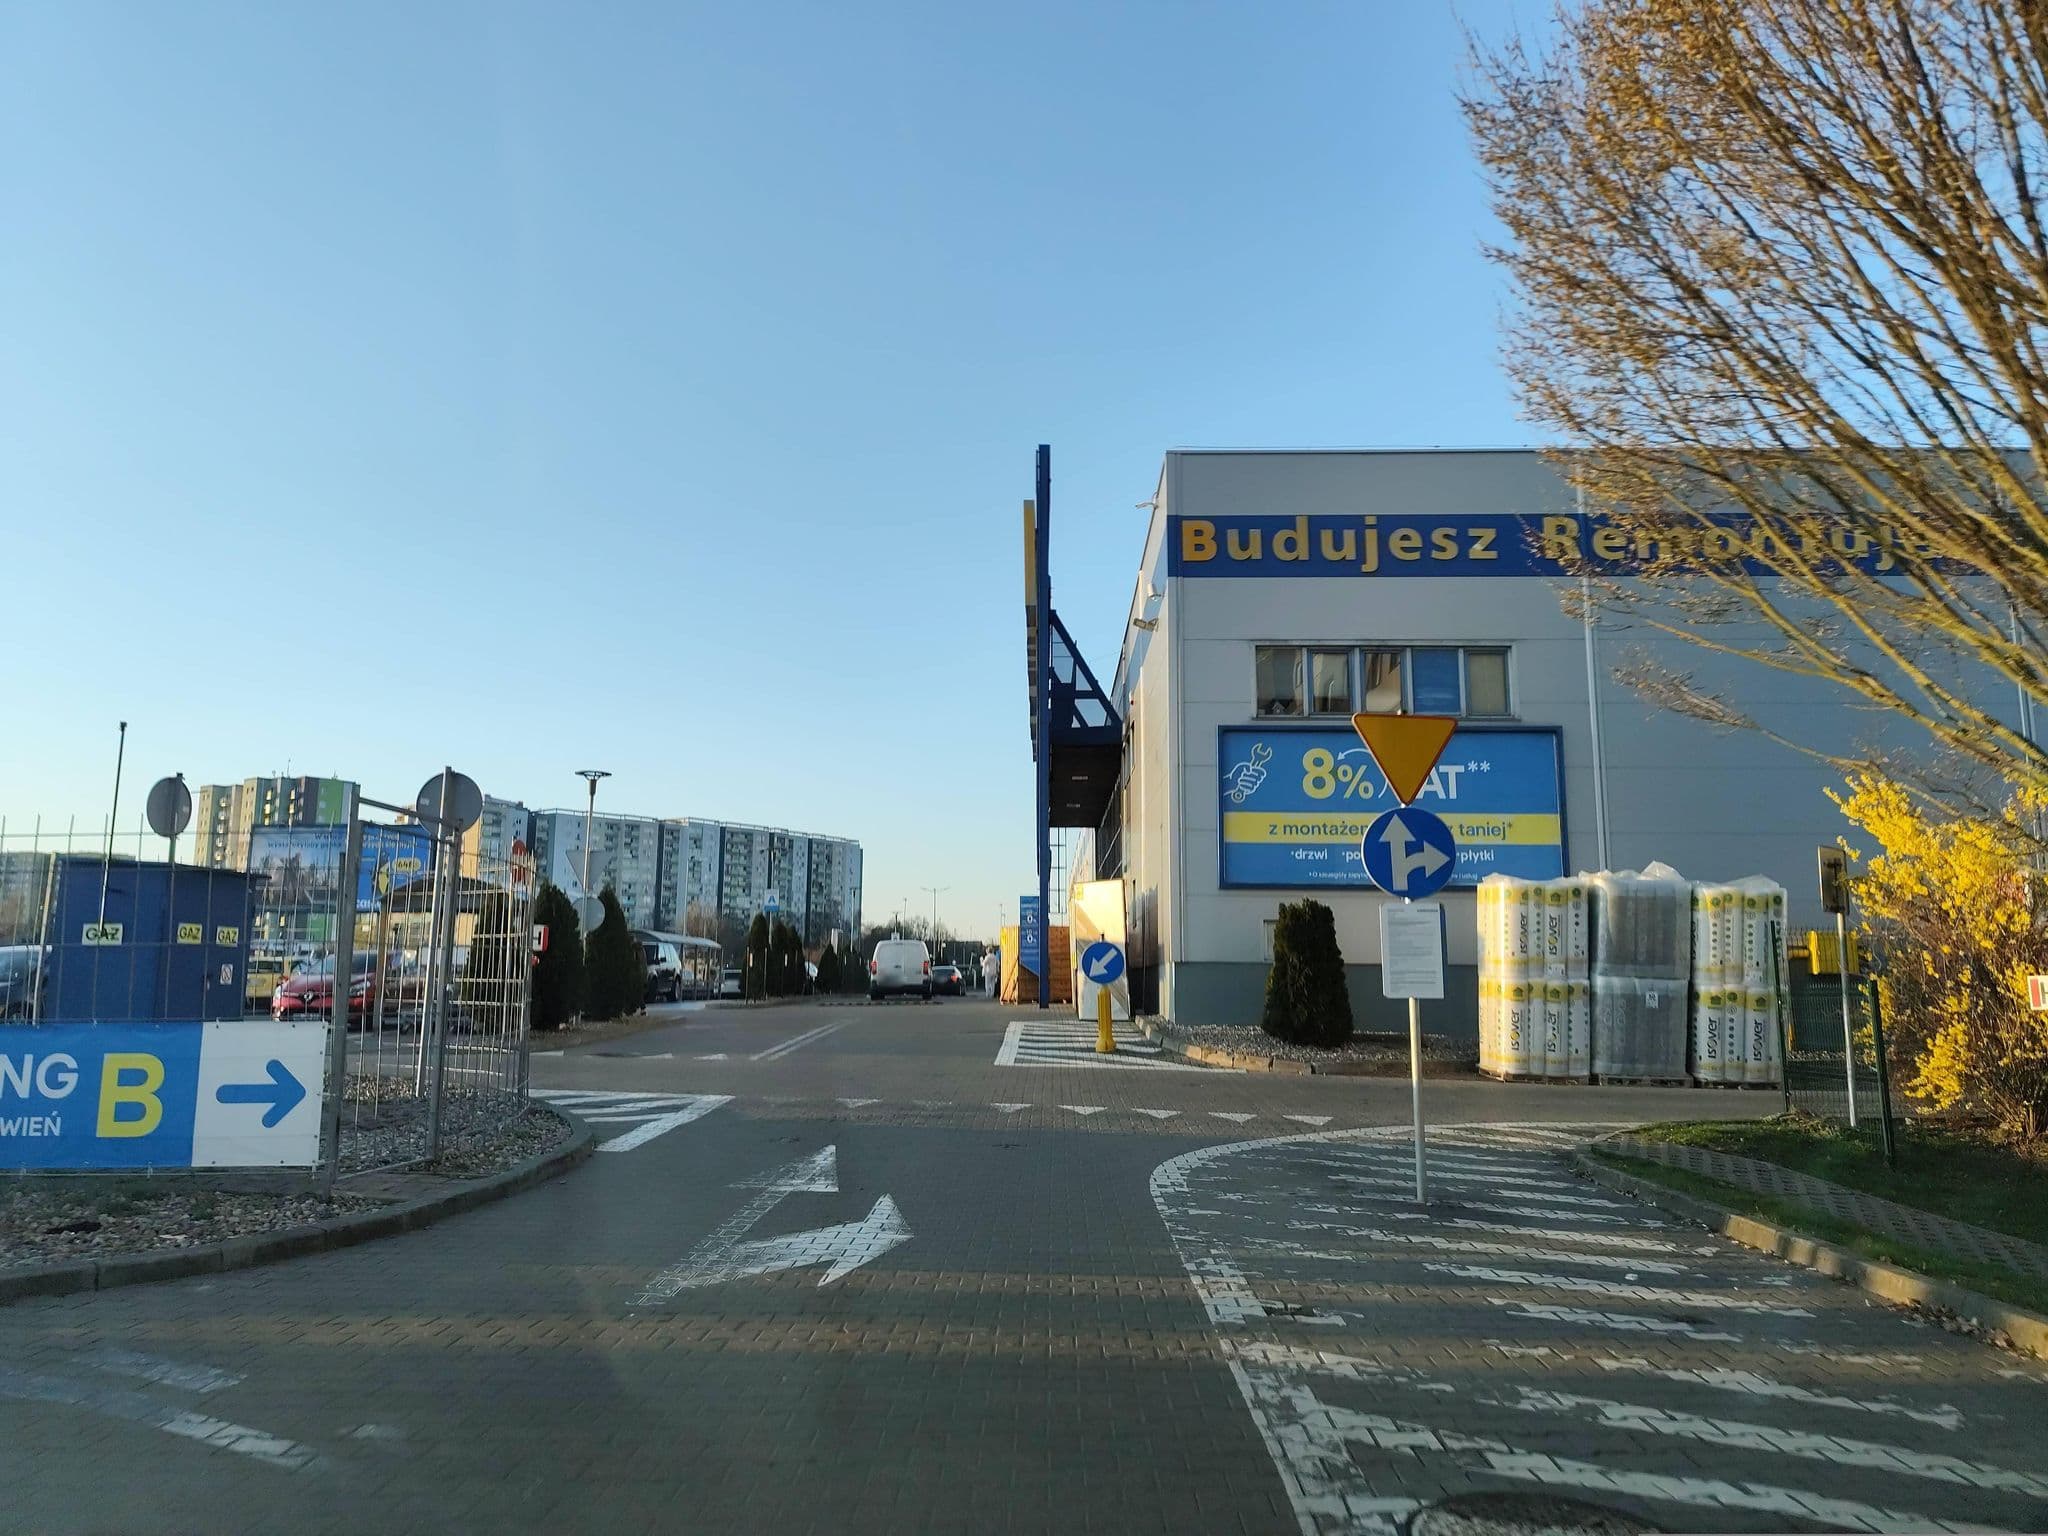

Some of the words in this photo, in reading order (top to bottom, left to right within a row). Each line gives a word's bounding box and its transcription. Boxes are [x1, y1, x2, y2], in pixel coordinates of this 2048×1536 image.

[1181, 515, 1499, 574] Budujesz
[1302, 747, 1375, 800] 8%
[1268, 823, 1278, 836] z
[85, 926, 120, 942] GAZ
[179, 926, 201, 940] GAZ
[217, 928, 237, 944] GAZ
[96, 1052, 166, 1139] B
